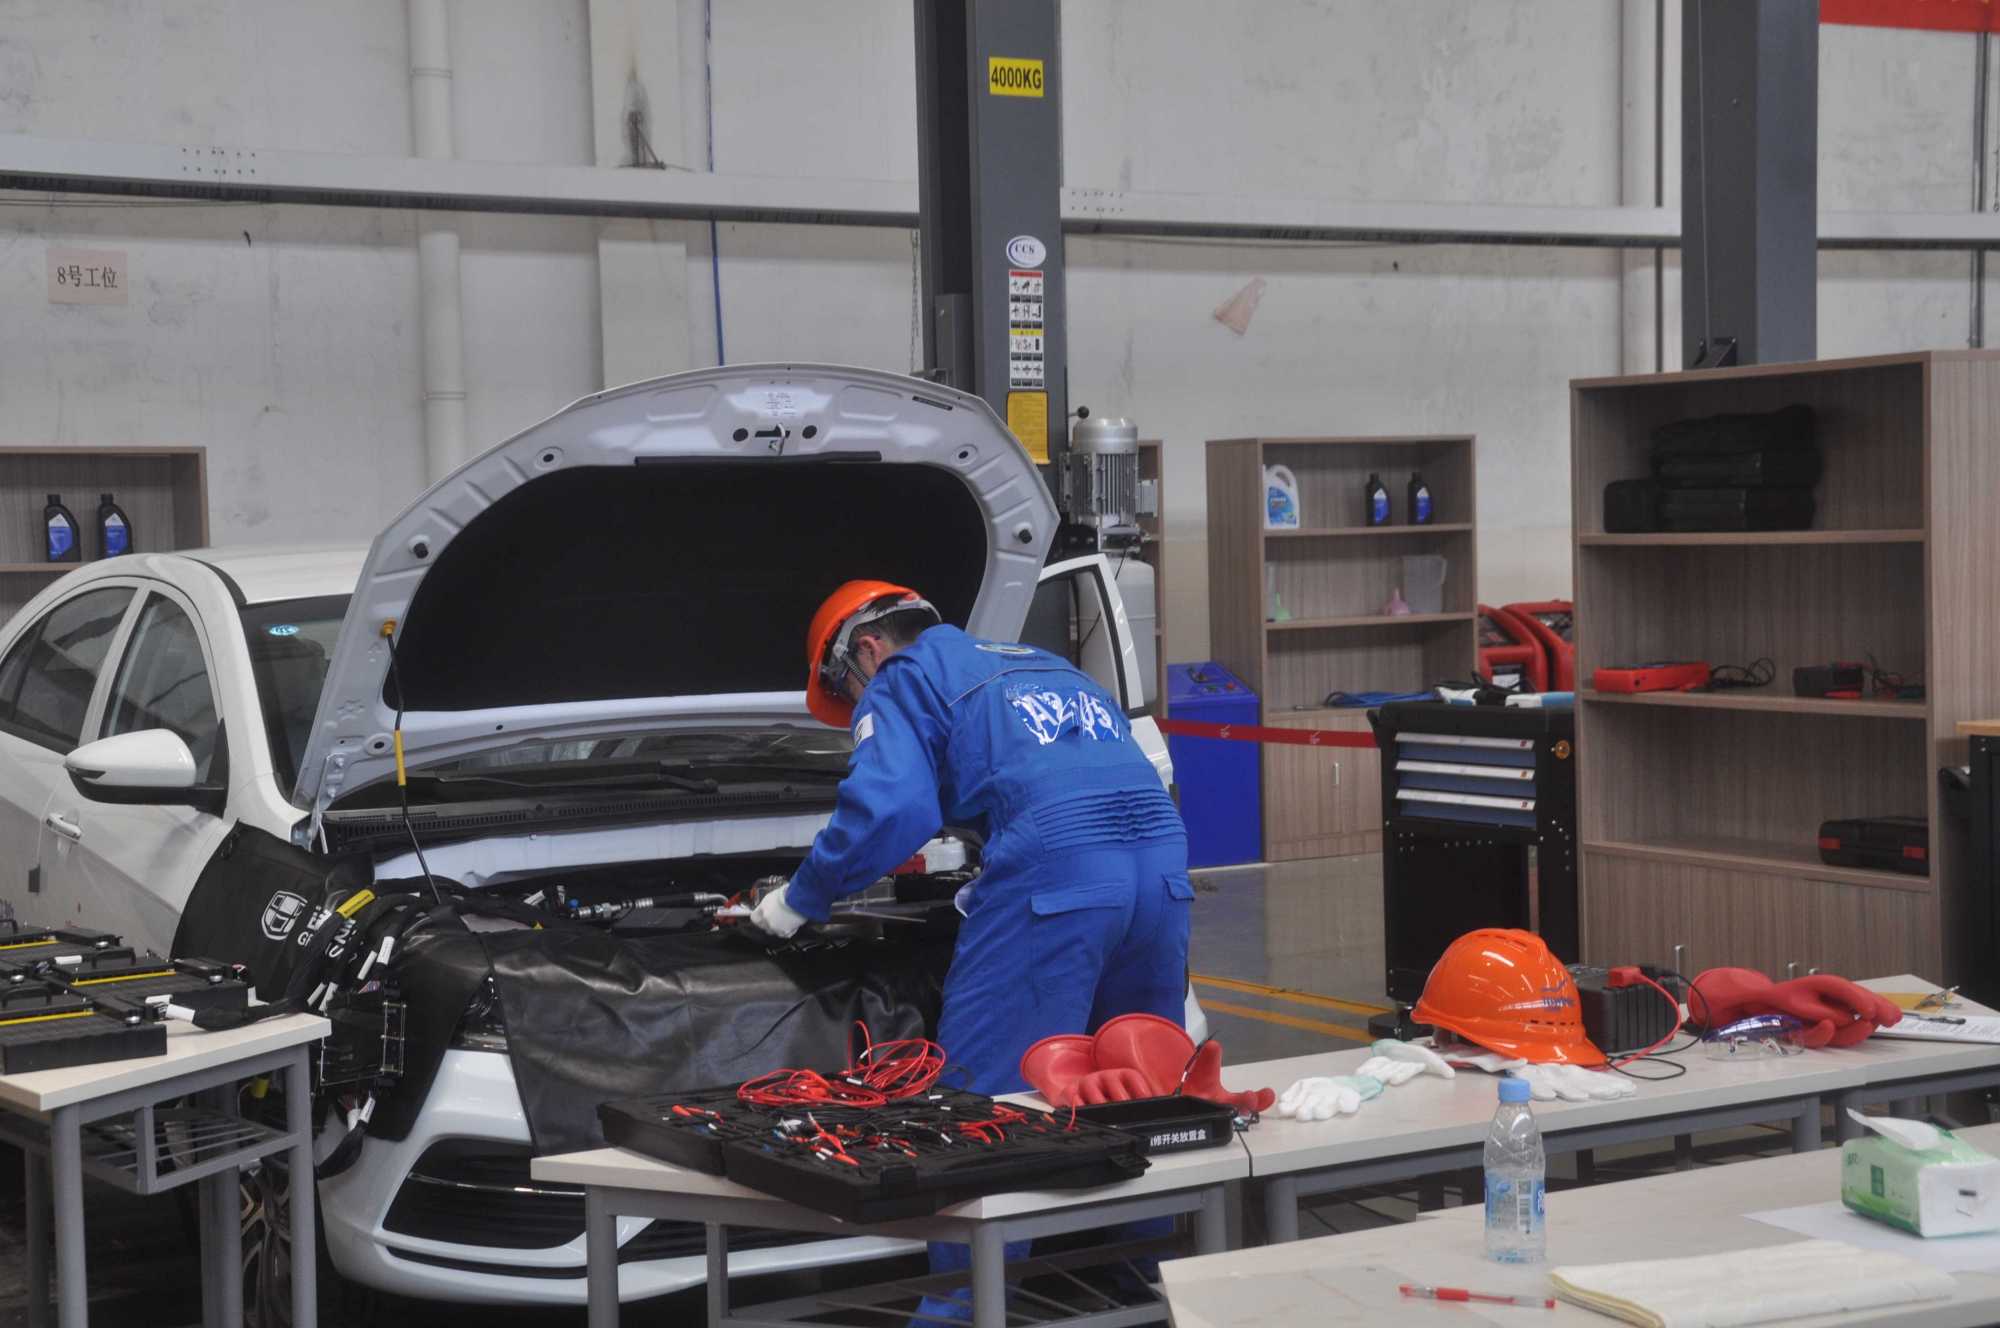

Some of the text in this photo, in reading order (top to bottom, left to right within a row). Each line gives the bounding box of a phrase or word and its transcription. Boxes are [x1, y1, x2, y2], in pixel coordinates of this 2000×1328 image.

[991, 66, 1042, 89] 4000KG
[57, 264, 119, 289] 8号工位
[1150, 1128, 1206, 1147] 修开关放置盒
